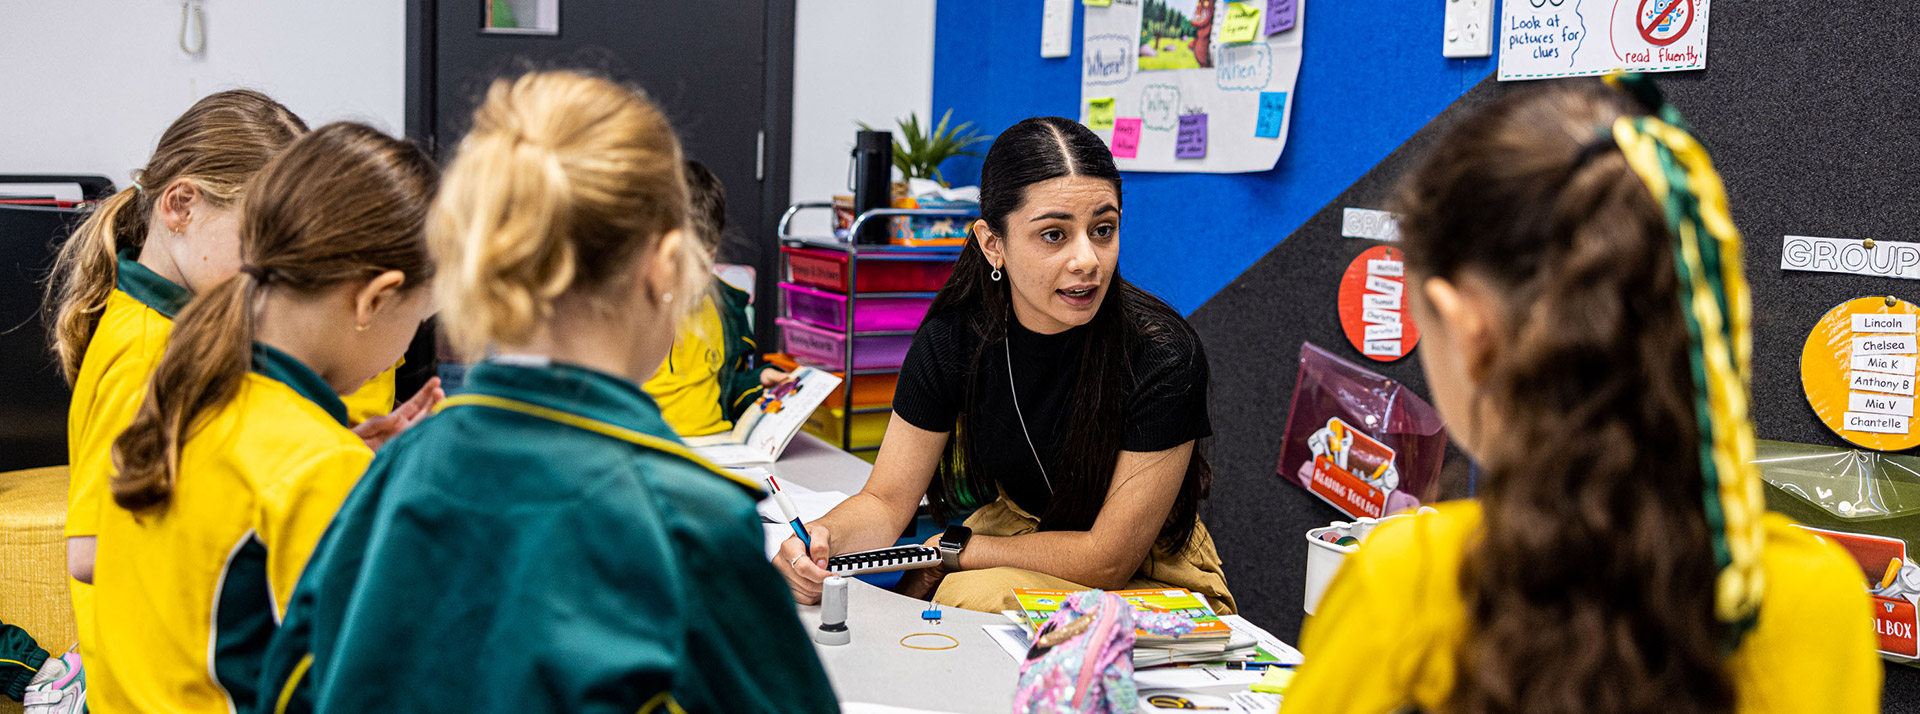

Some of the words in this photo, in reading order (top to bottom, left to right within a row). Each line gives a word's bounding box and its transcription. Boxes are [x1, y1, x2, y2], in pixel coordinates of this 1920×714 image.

[1512, 15, 1542, 31] Look
[1546, 14, 1561, 28] at
[1509, 33, 1555, 53] pictures
[1562, 26, 1580, 43] for
[1087, 47, 1126, 77] Where?
[1533, 45, 1560, 60] clues
[1625, 48, 1650, 63] read
[1658, 45, 1698, 66] fluently
[1221, 50, 1265, 81] When?
[1146, 91, 1175, 120] Why?
[1345, 211, 1400, 240] GRO
[1783, 239, 1920, 276] GROUP
[1863, 317, 1903, 329] Lincoln
[1862, 340, 1906, 351] Chelsea
[1867, 357, 1889, 369] Mia
[1891, 359, 1899, 370] K
[1854, 376, 1900, 391] Anthony
[1902, 380, 1910, 391] B
[1865, 398, 1886, 410] Mia
[1888, 400, 1897, 411] V
[1850, 416, 1902, 429] Chantelle
[1314, 468, 1347, 497] READING
[1347, 489, 1381, 518] TOOLBOX
